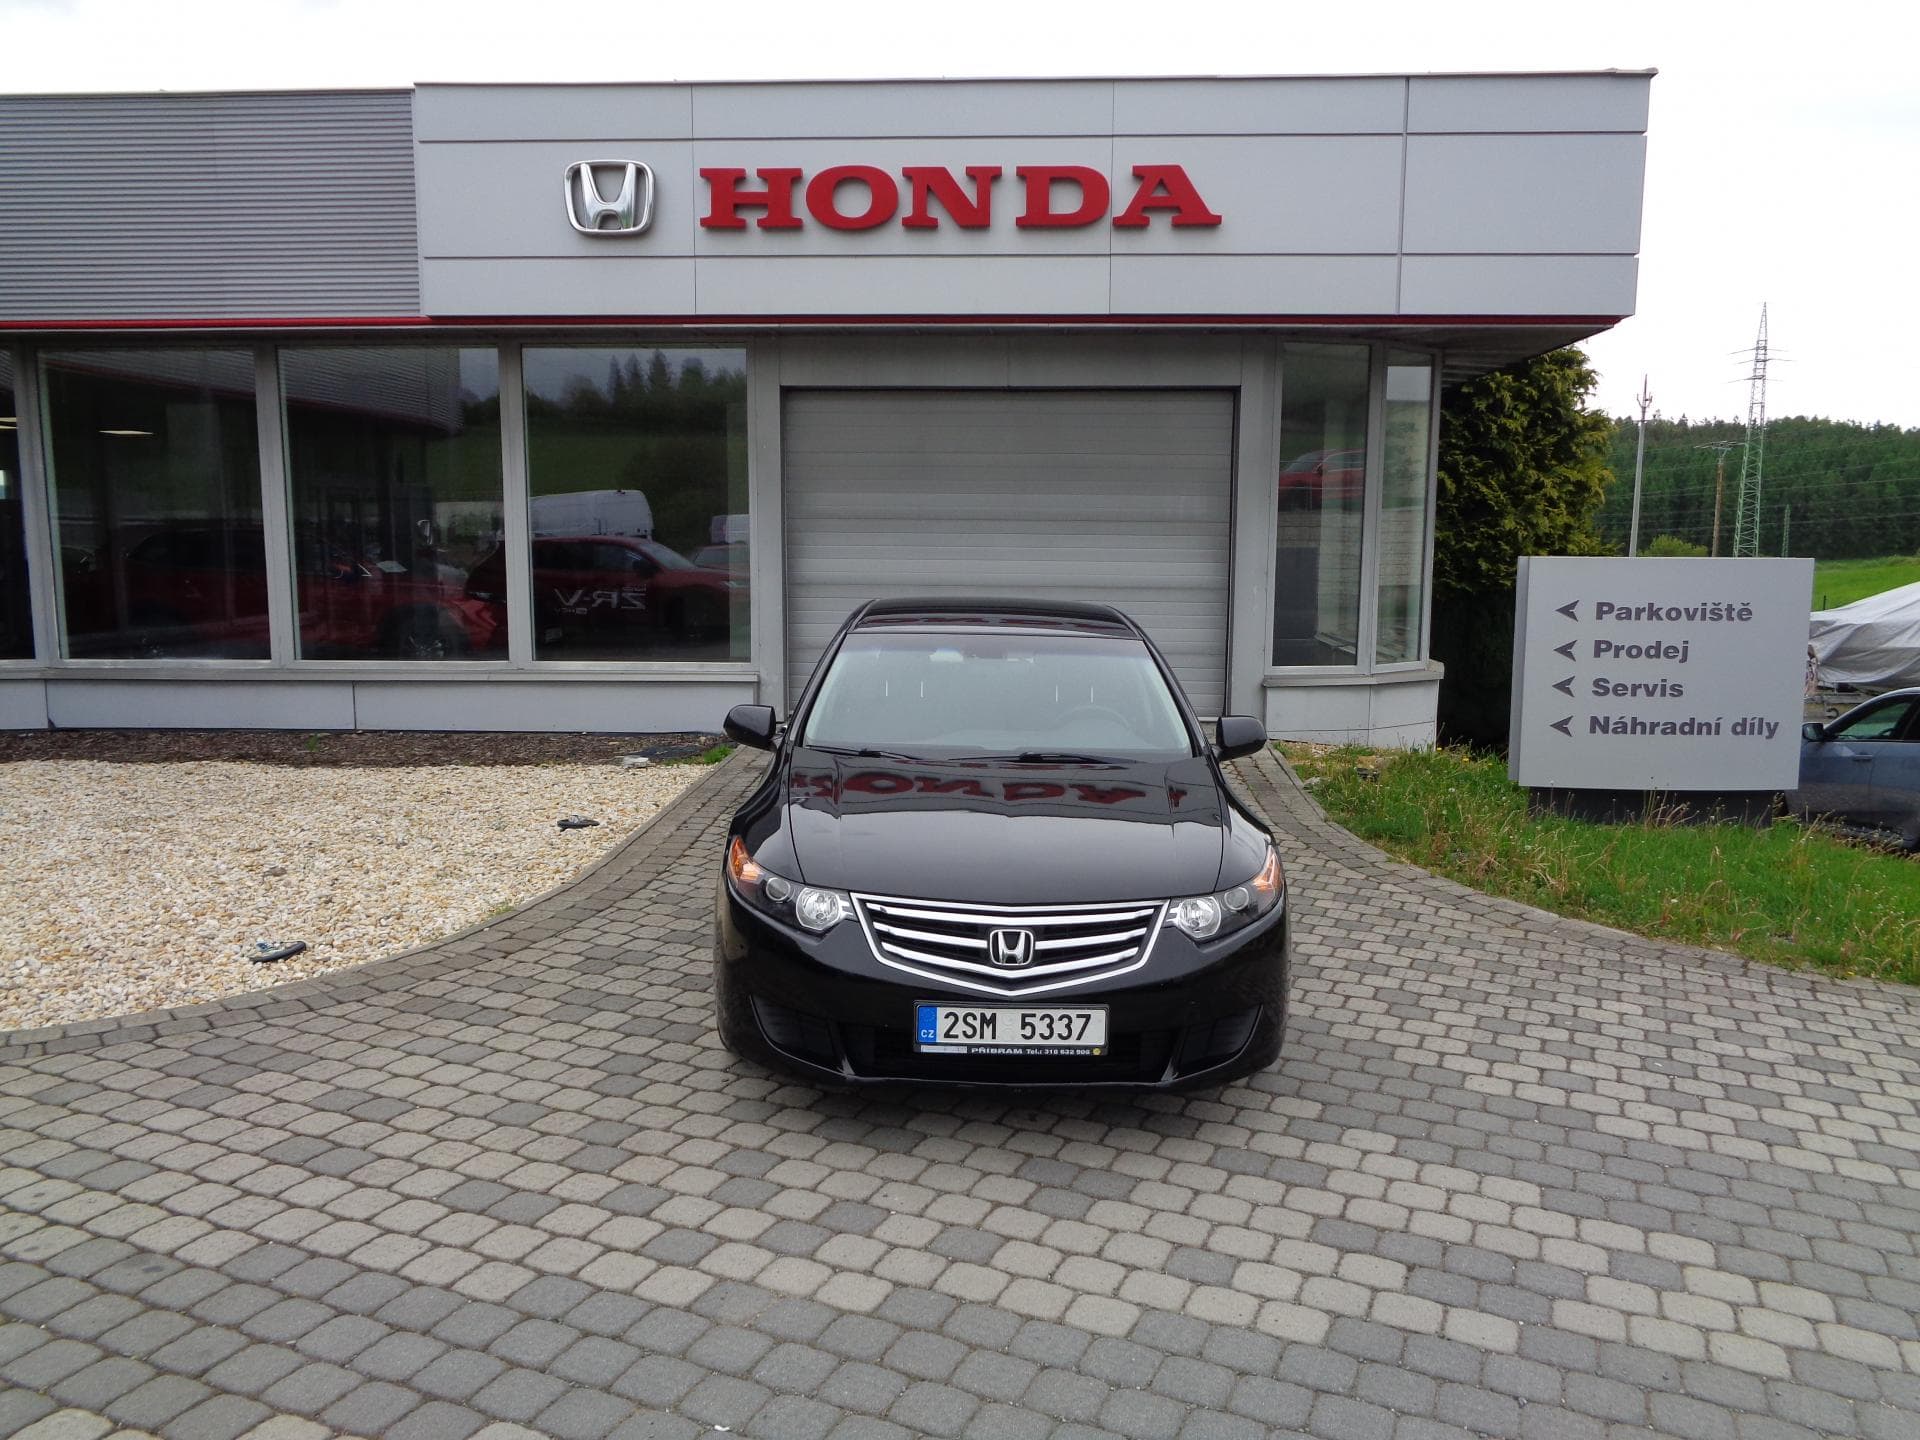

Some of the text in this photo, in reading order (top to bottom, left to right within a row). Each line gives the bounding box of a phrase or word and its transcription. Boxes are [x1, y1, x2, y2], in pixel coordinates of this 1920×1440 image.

[699, 165, 1223, 230] HONDA
[1595, 601, 1753, 622] Parkoviště
[1593, 639, 1689, 663] Prodej
[1591, 677, 1684, 698] Servis
[1589, 715, 1780, 740] Náhradní díly
[920, 1029, 935, 1038] CZ
[943, 1011, 1092, 1041] 2SM 5337
